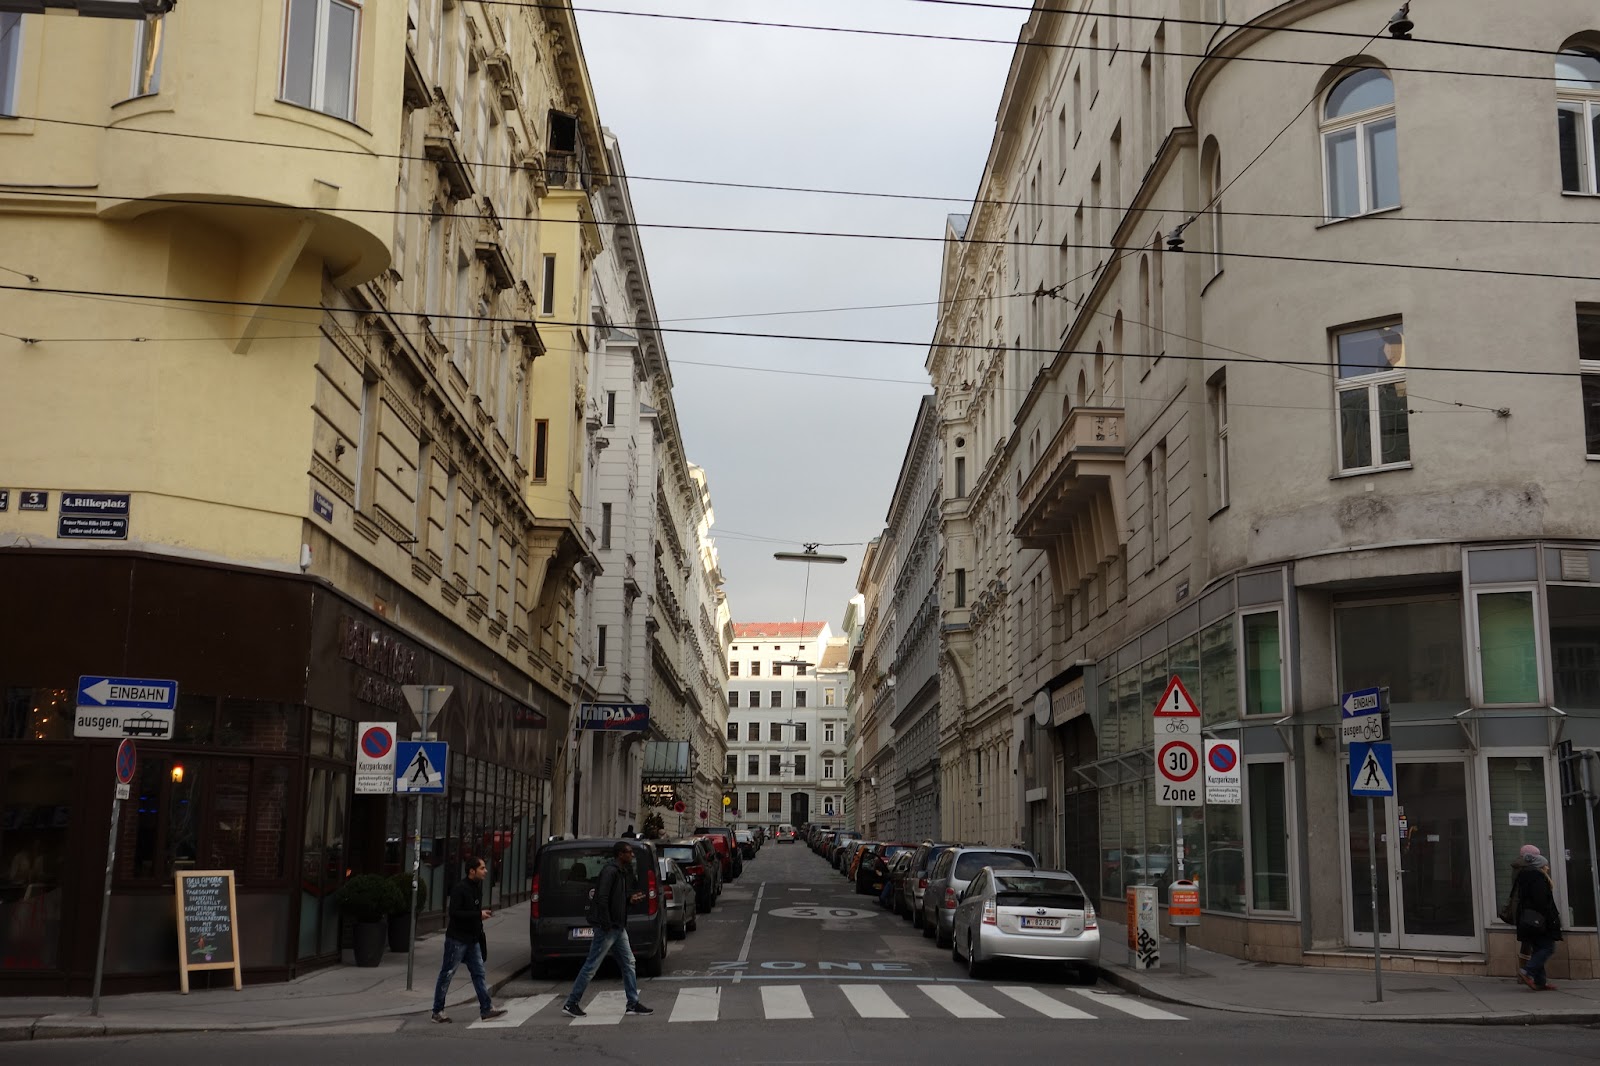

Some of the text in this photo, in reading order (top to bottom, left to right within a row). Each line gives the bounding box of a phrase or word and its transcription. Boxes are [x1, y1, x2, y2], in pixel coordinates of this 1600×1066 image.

[29, 493, 39, 503] 3
[75, 498, 127, 509] Rilkeplatz
[110, 686, 164, 701] EINBAHN
[1354, 695, 1376, 710] EINBAHN
[78, 716, 121, 730] ausgen.
[1344, 725, 1364, 738] ausgen.
[1169, 752, 1188, 771] 30
[643, 784, 674, 793] HOTEL
[1163, 785, 1196, 801] Zone
[792, 908, 858, 917] 30
[708, 961, 912, 972] ZONE
